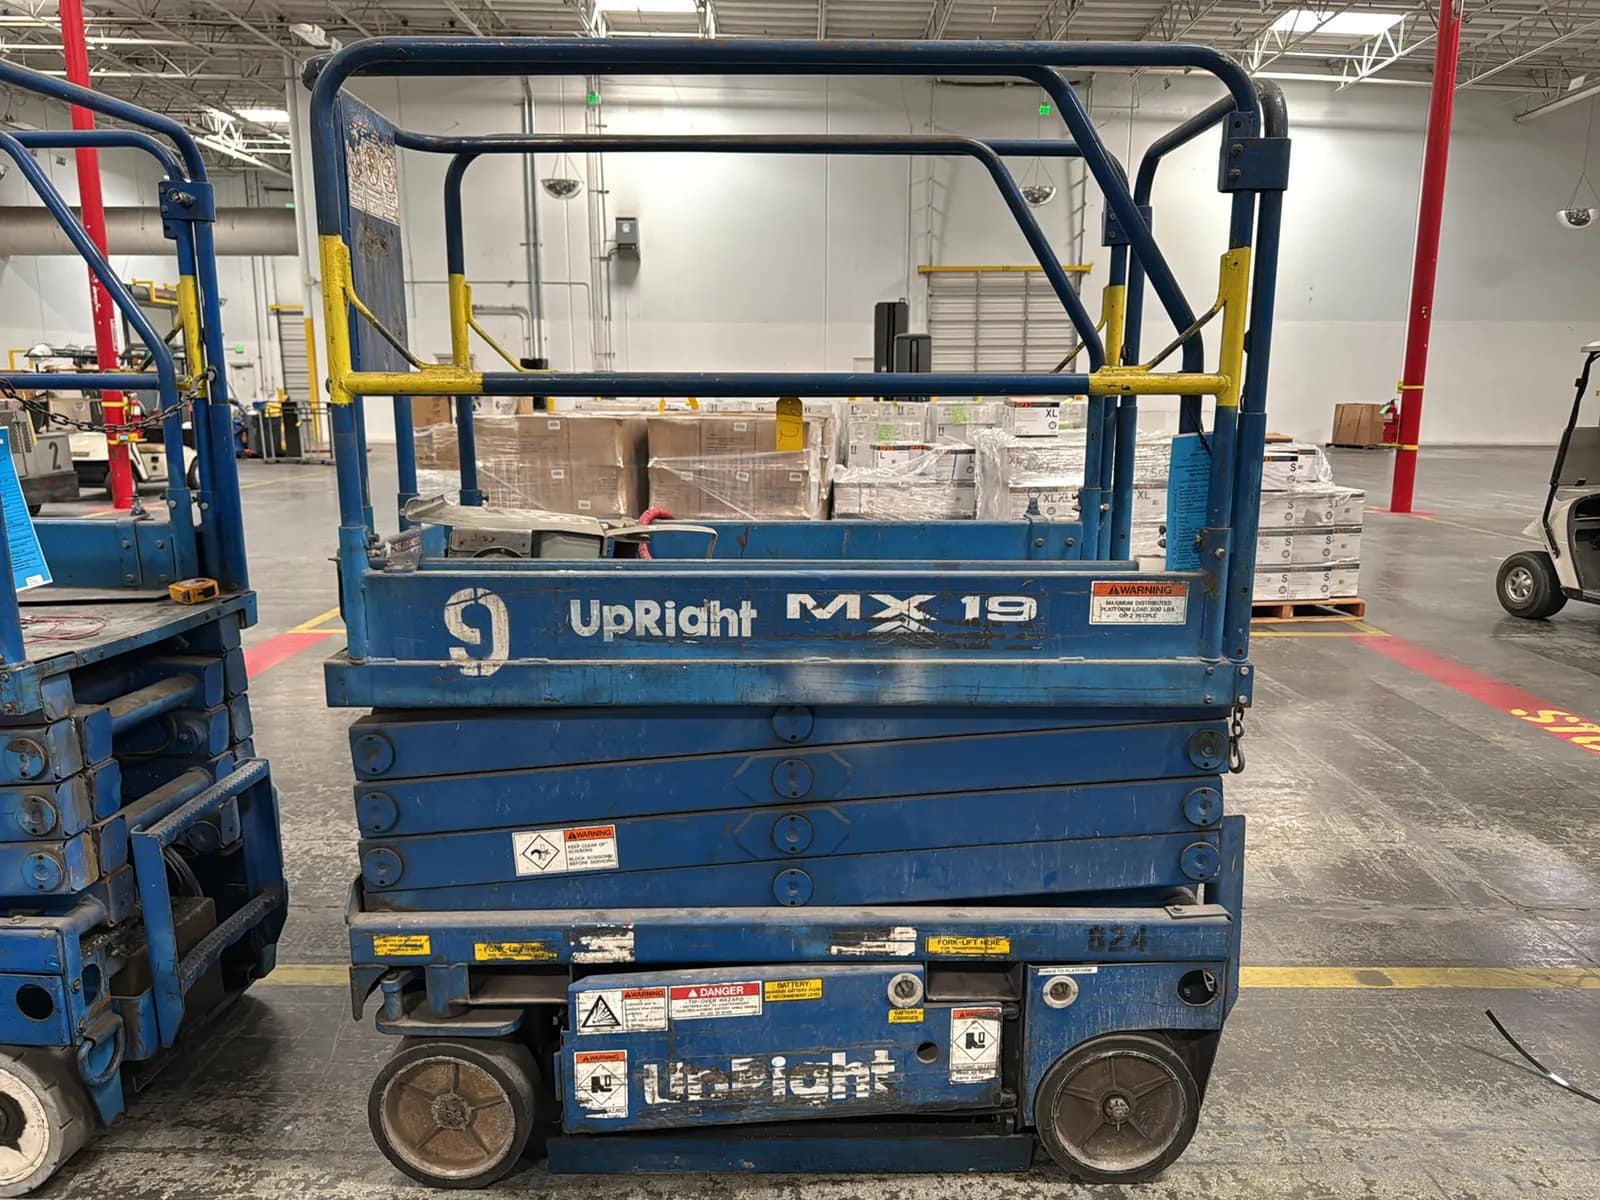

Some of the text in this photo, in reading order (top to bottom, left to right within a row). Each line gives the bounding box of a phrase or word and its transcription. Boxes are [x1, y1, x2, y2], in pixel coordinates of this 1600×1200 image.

[1044, 409, 1058, 418] XL
[49, 441, 61, 470] 2
[1290, 462, 1297, 472] S
[1043, 494, 1057, 503] XL
[1137, 490, 1151, 500] XL
[1287, 501, 1294, 510] S
[1284, 537, 1291, 547] S
[1325, 535, 1332, 545] S
[1281, 574, 1288, 584] S
[1323, 572, 1330, 582] S
[1120, 585, 1172, 595] WARNING
[786, 593, 1038, 624] MX 19
[569, 599, 758, 642] UpRight
[444, 587, 509, 677] 9
[576, 829, 612, 840] WARNING
[1087, 925, 1147, 953] 824
[700, 986, 744, 997] DANGER
